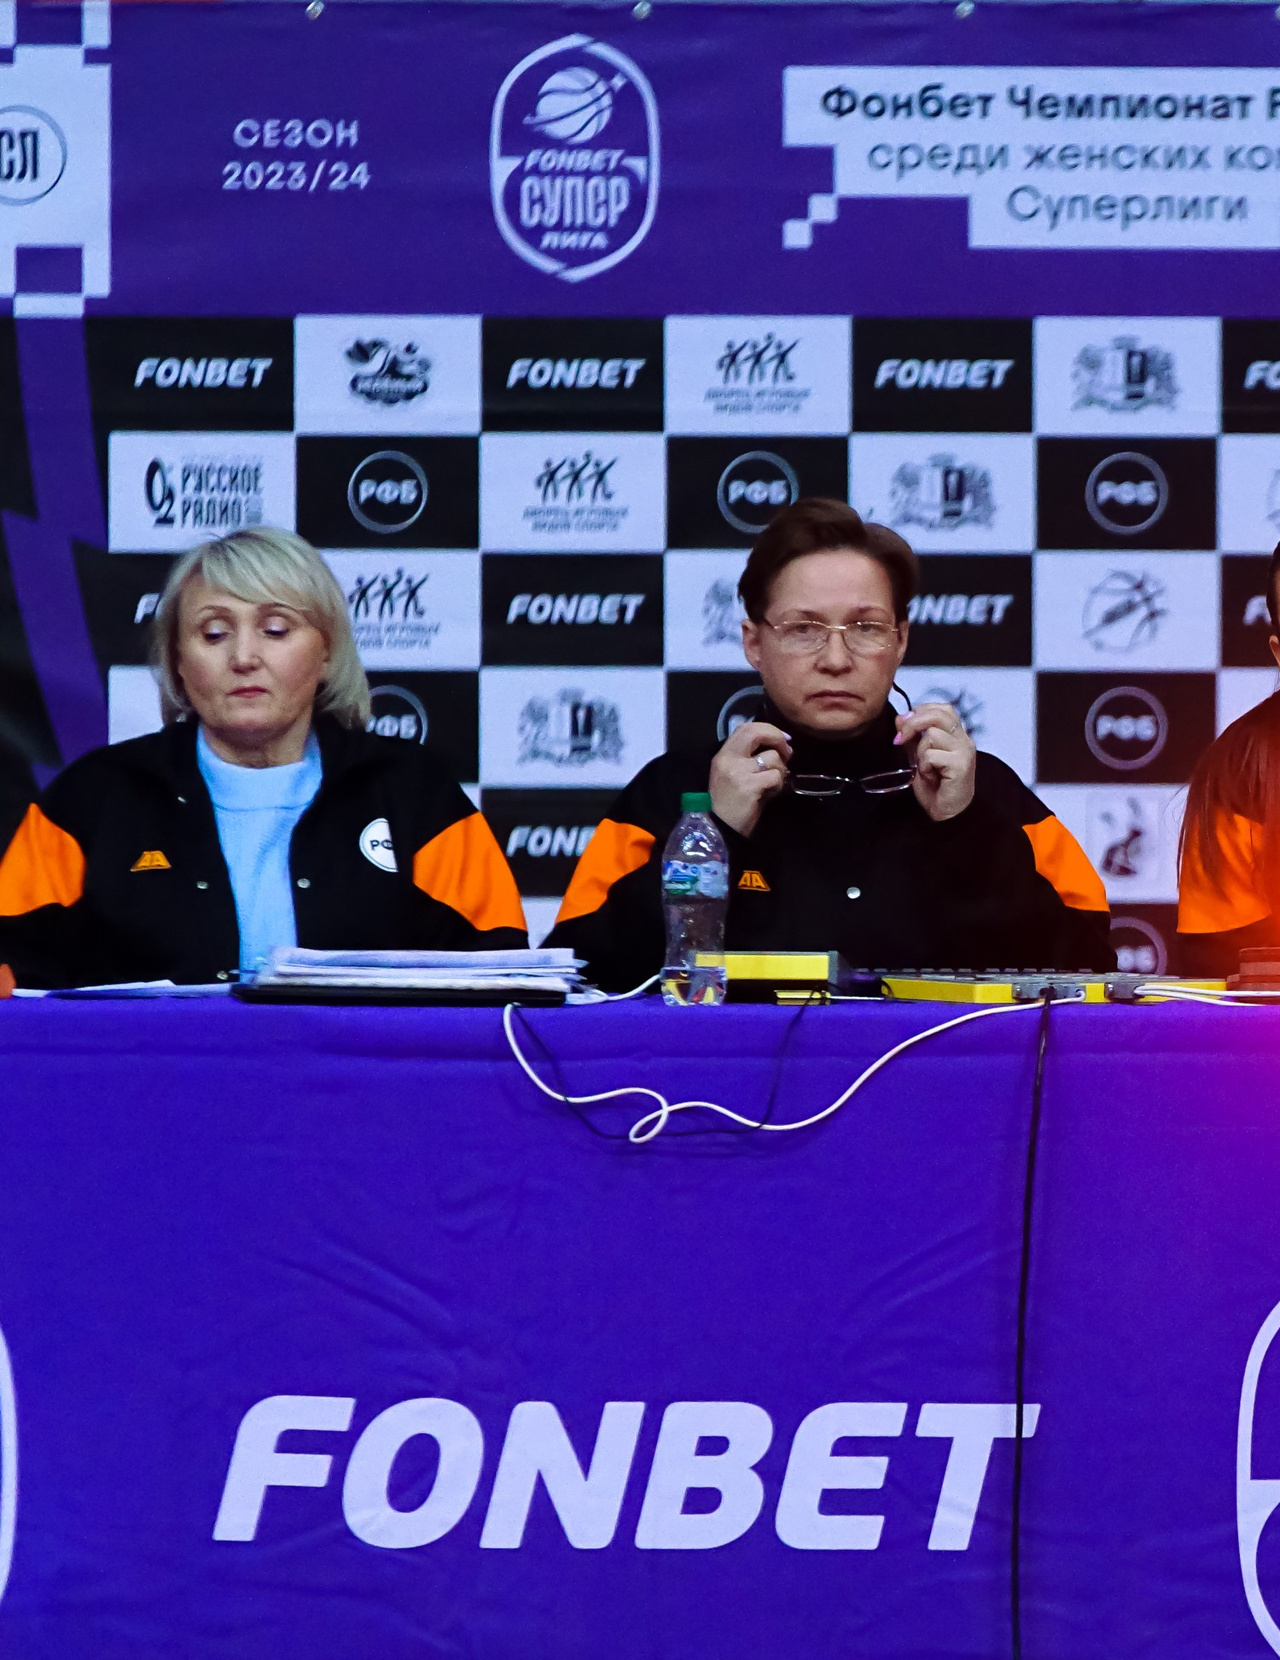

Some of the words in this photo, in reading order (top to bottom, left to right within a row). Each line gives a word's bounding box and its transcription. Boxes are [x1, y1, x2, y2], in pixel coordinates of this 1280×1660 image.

[822, 85, 995, 120] Фонбет
[1008, 86, 1255, 121] Чемпионат
[233, 118, 360, 149] СЕЗОН
[222, 160, 372, 193] 2023/24
[524, 150, 626, 173] FONBET
[868, 143, 1010, 180] среди
[1024, 144, 1211, 172] женских
[1006, 184, 1249, 232] Суперлиги
[540, 231, 610, 250] ЛИГА
[134, 357, 274, 389] FONBET
[507, 358, 648, 390] FONBET
[875, 359, 1015, 390] FONBET
[181, 463, 262, 494] РУССКОЕ
[359, 479, 418, 505] РФБ
[507, 593, 646, 625] FONBET
[213, 1395, 1042, 1551] FONBET
